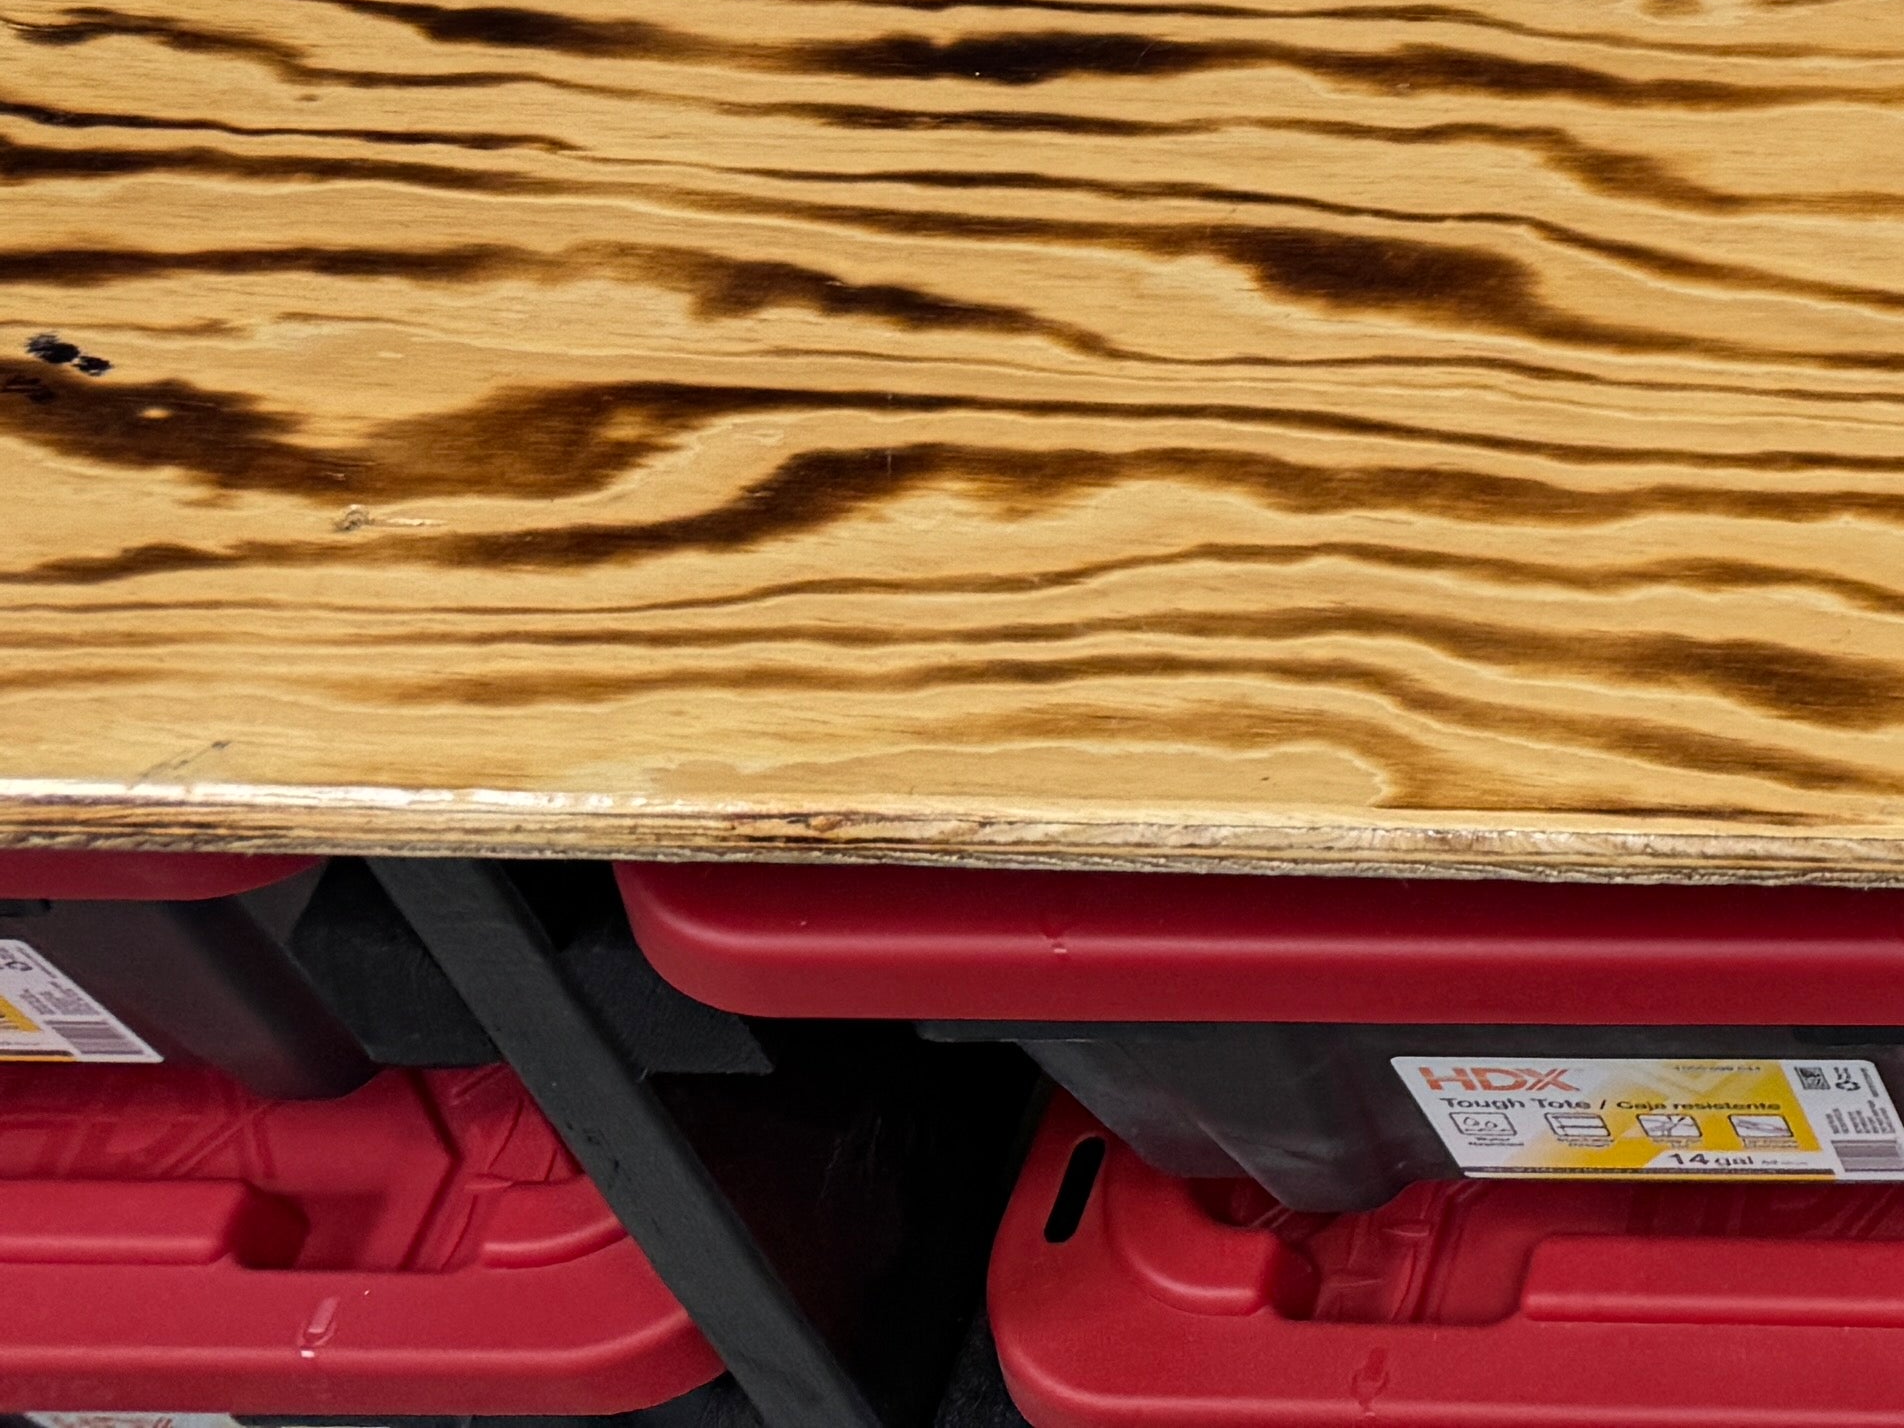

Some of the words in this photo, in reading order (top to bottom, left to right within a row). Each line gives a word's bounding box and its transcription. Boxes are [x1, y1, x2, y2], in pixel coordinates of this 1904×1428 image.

[1417, 1066, 1582, 1093] HDX
[1439, 1097, 1526, 1111] Tough
[1529, 1097, 1592, 1110] Tote
[1668, 1152, 1710, 1166] 14
[1714, 1155, 1755, 1167] gal
